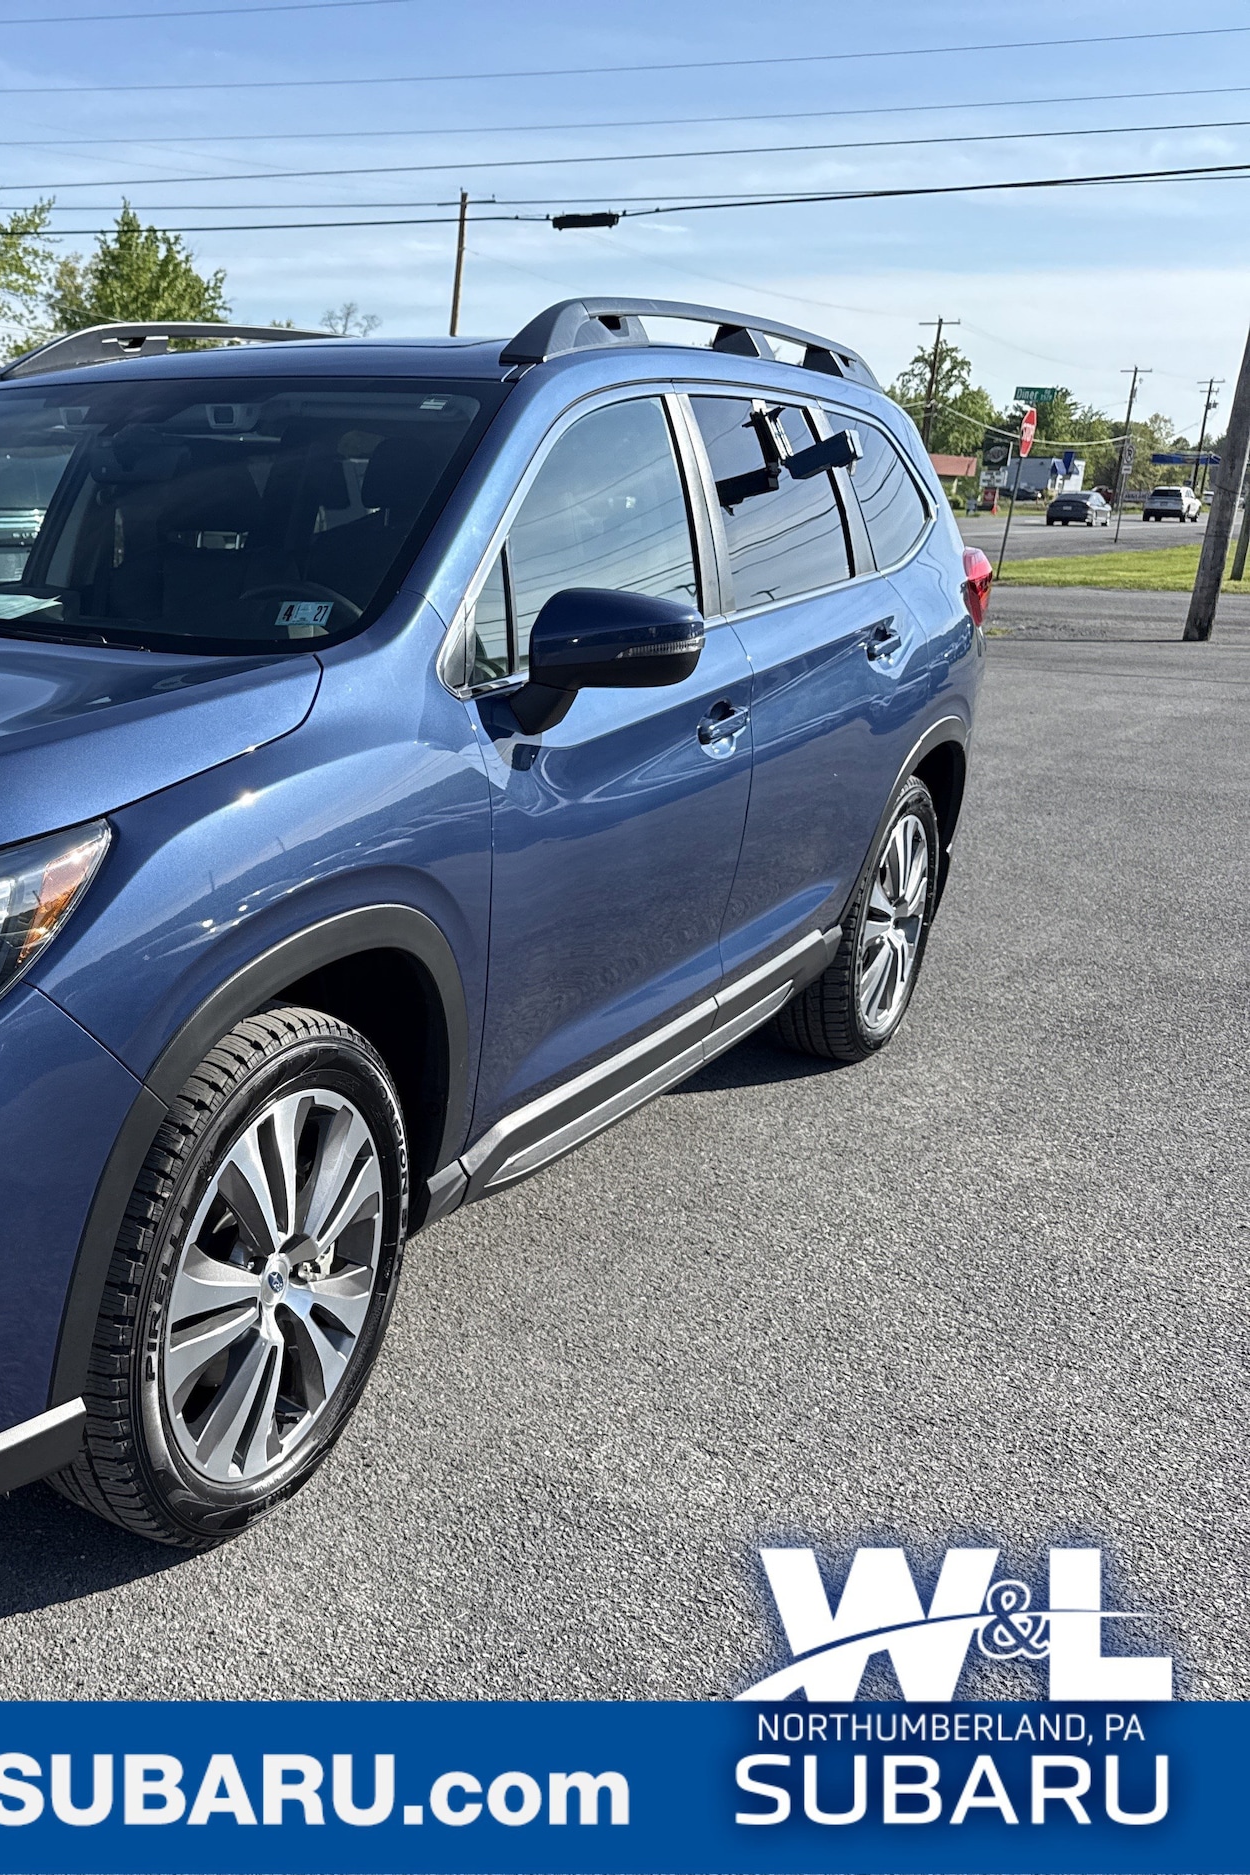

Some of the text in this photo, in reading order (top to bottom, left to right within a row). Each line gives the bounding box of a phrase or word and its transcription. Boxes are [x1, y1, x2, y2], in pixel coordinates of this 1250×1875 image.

[1016, 388, 1039, 400] Diner
[1021, 423, 1035, 442] STOP
[282, 604, 329, 623] 4 27
